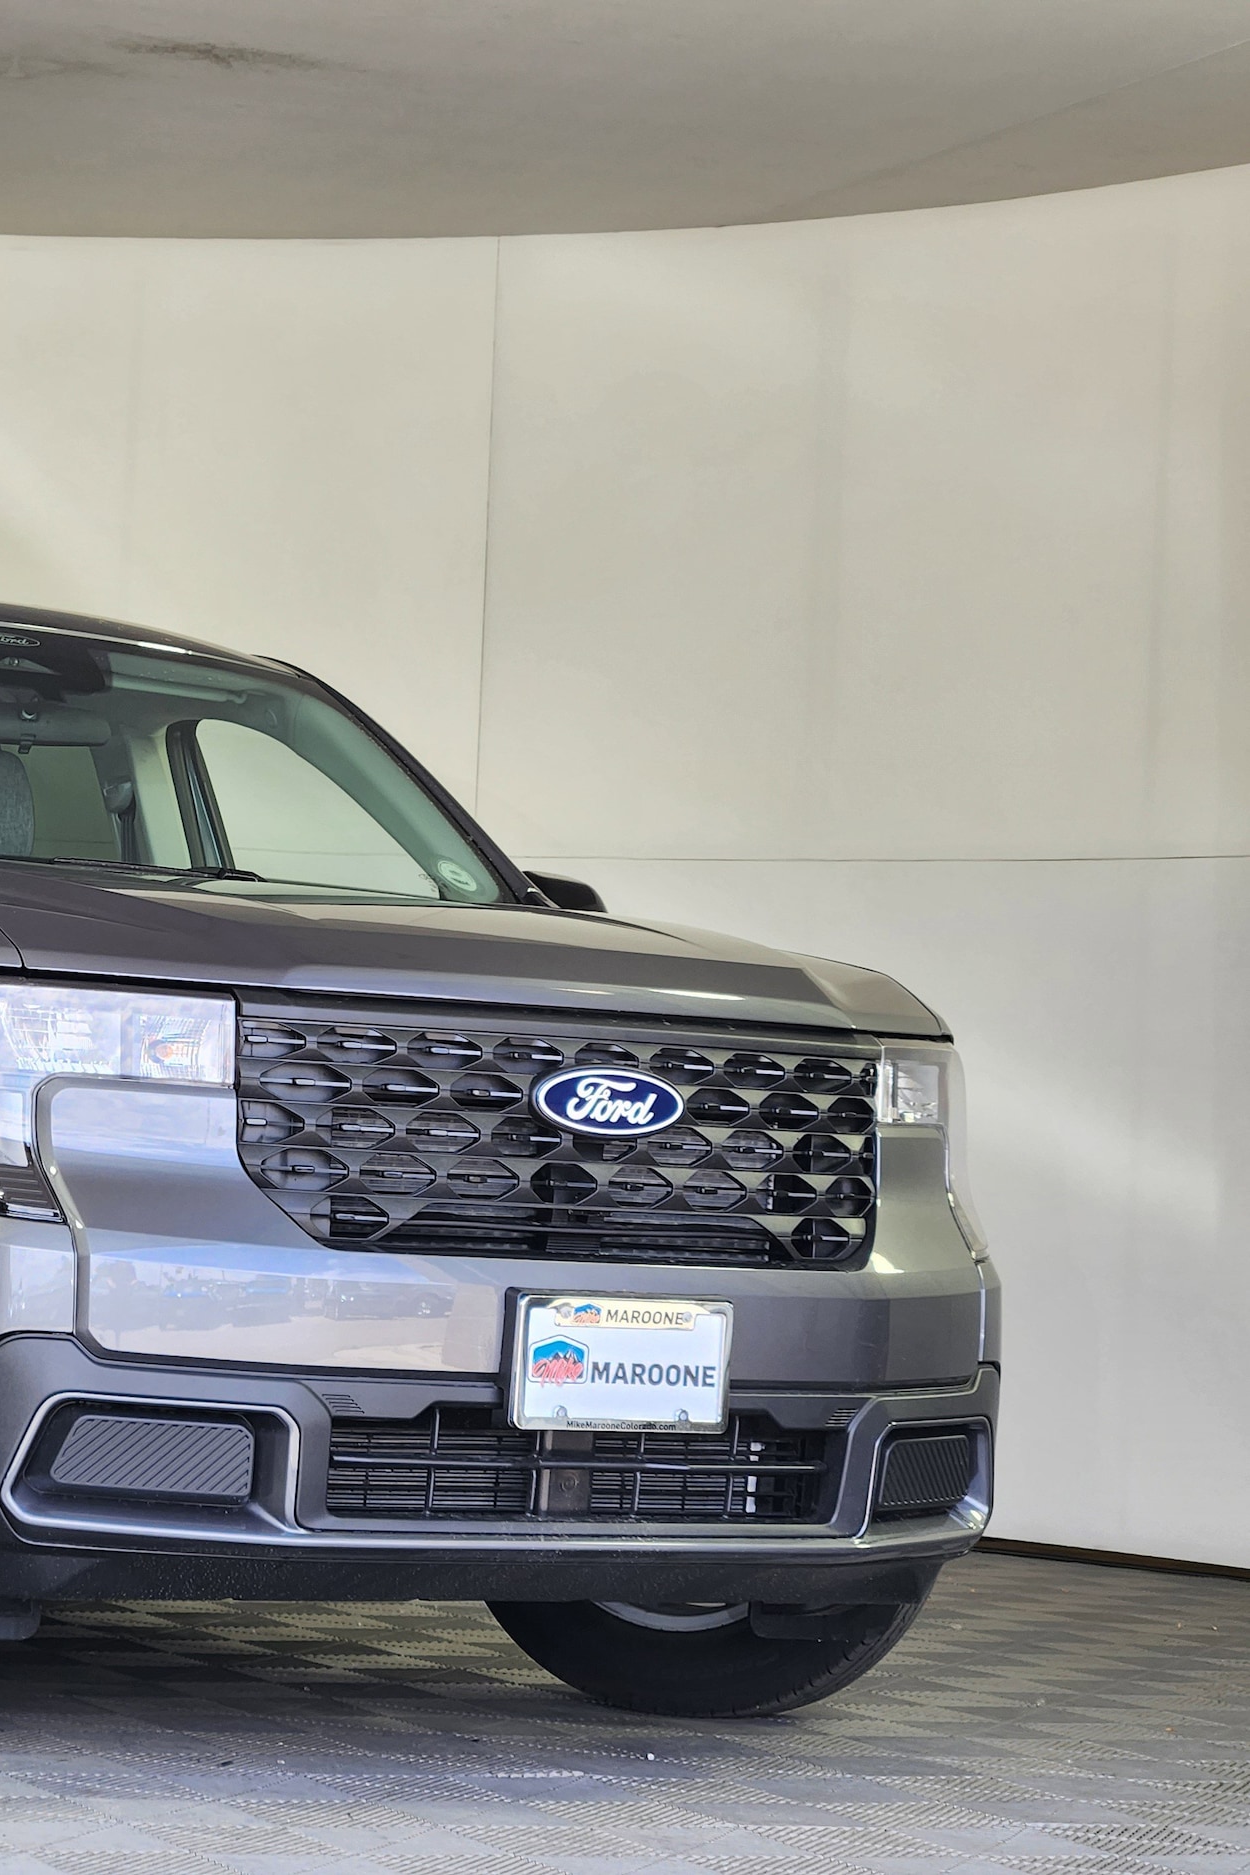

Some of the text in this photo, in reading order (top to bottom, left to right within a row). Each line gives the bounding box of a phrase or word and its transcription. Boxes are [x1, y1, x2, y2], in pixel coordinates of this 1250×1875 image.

[566, 1077, 657, 1125] Ford
[605, 1308, 684, 1326] MAROONE
[531, 1356, 716, 1388] Mike MAROONE
